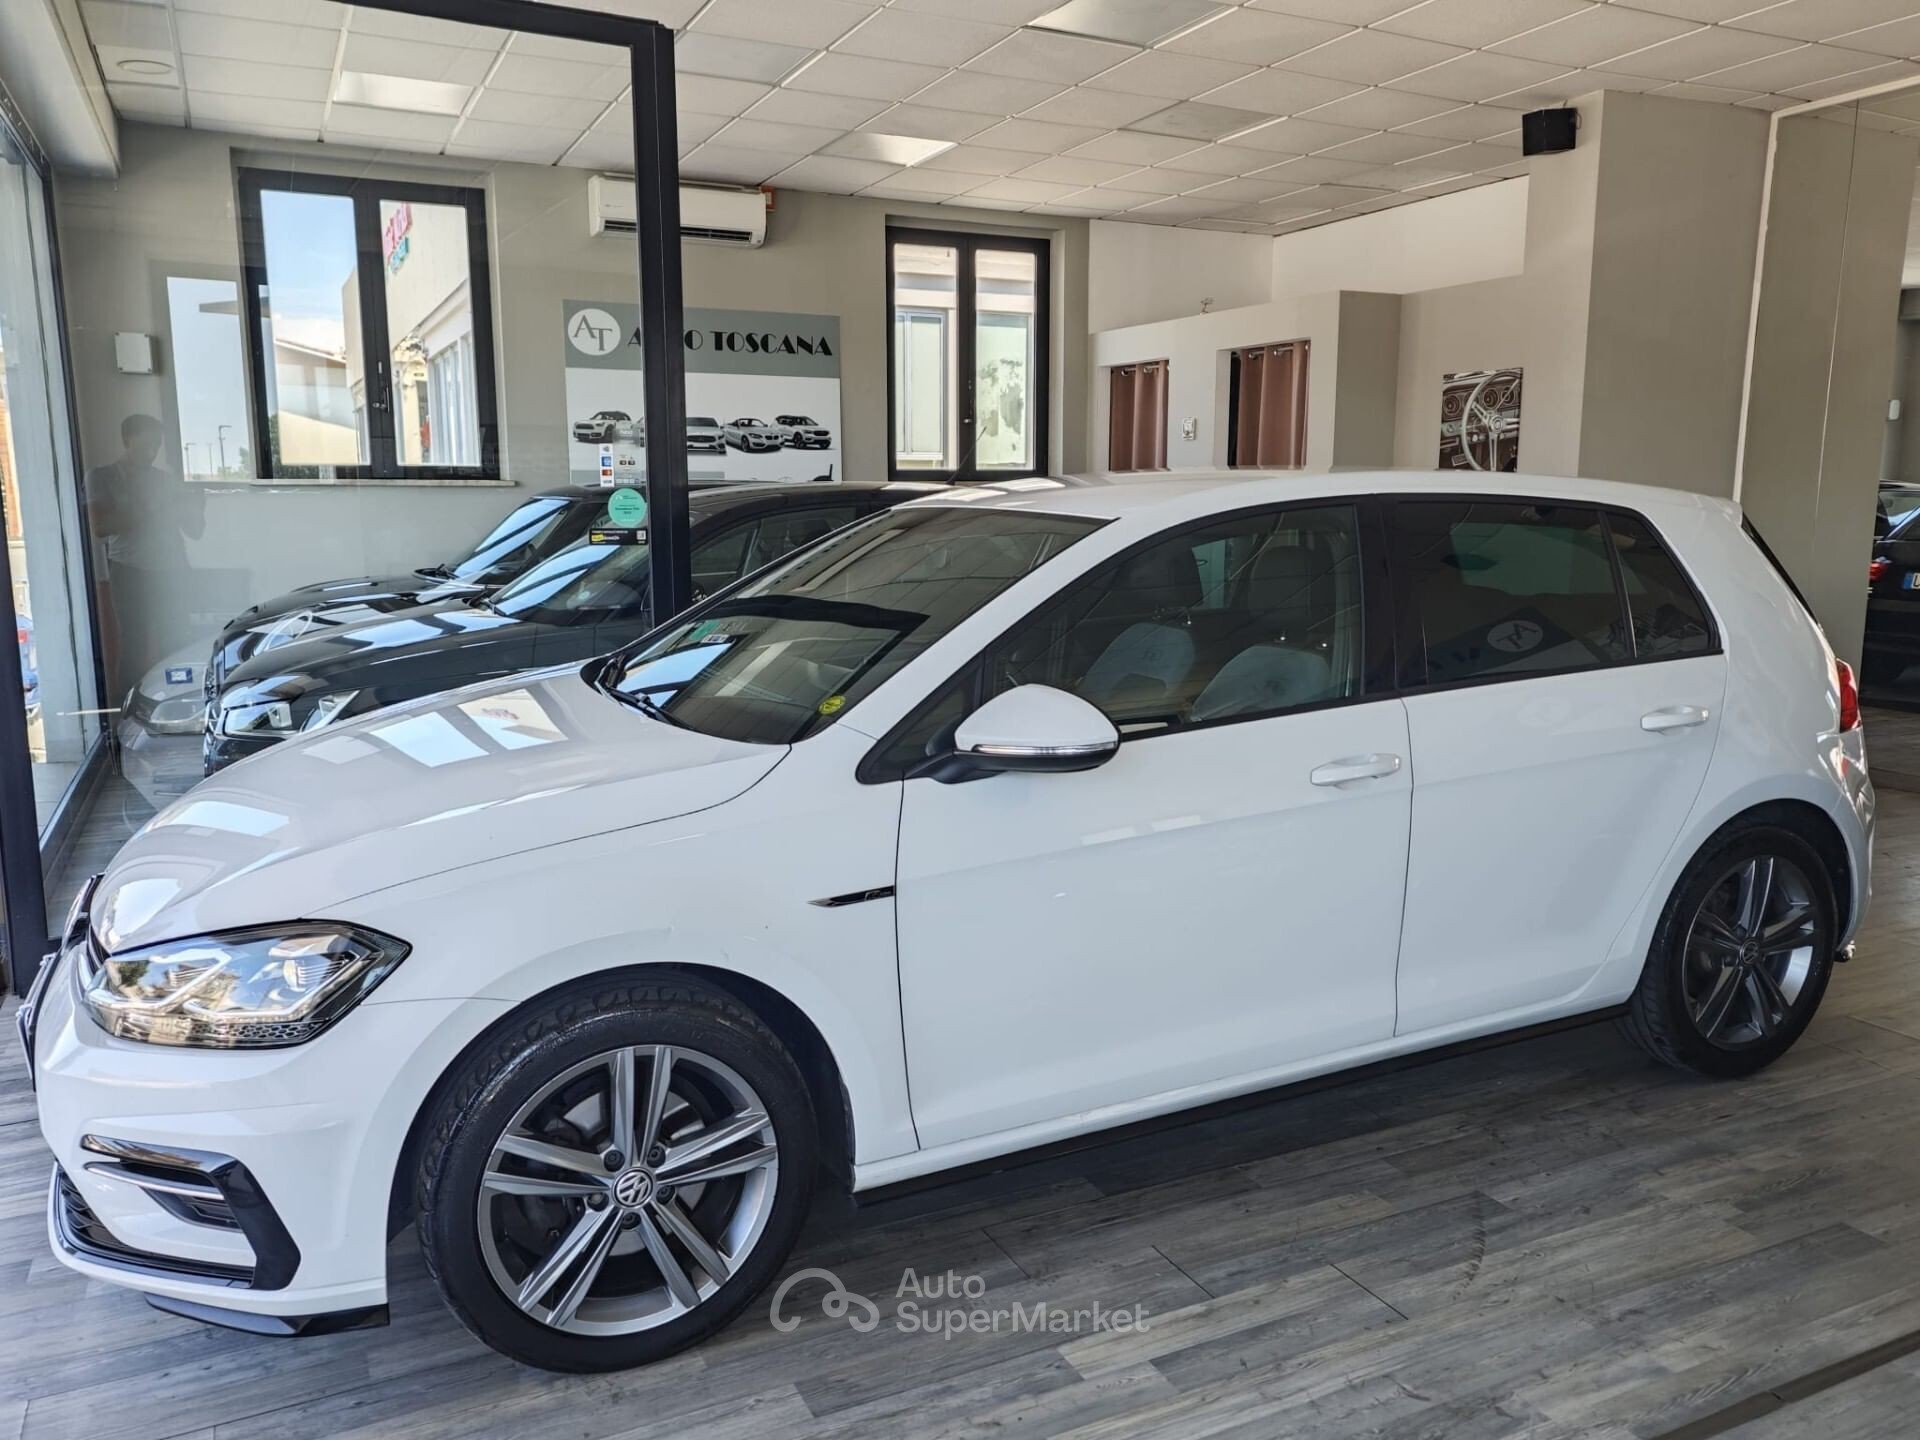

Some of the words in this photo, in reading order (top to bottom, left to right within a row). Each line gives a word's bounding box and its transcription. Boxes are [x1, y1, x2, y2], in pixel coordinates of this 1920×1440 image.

[572, 313, 613, 352] AT
[627, 326, 704, 351] AO
[709, 330, 833, 357] TOSCANA
